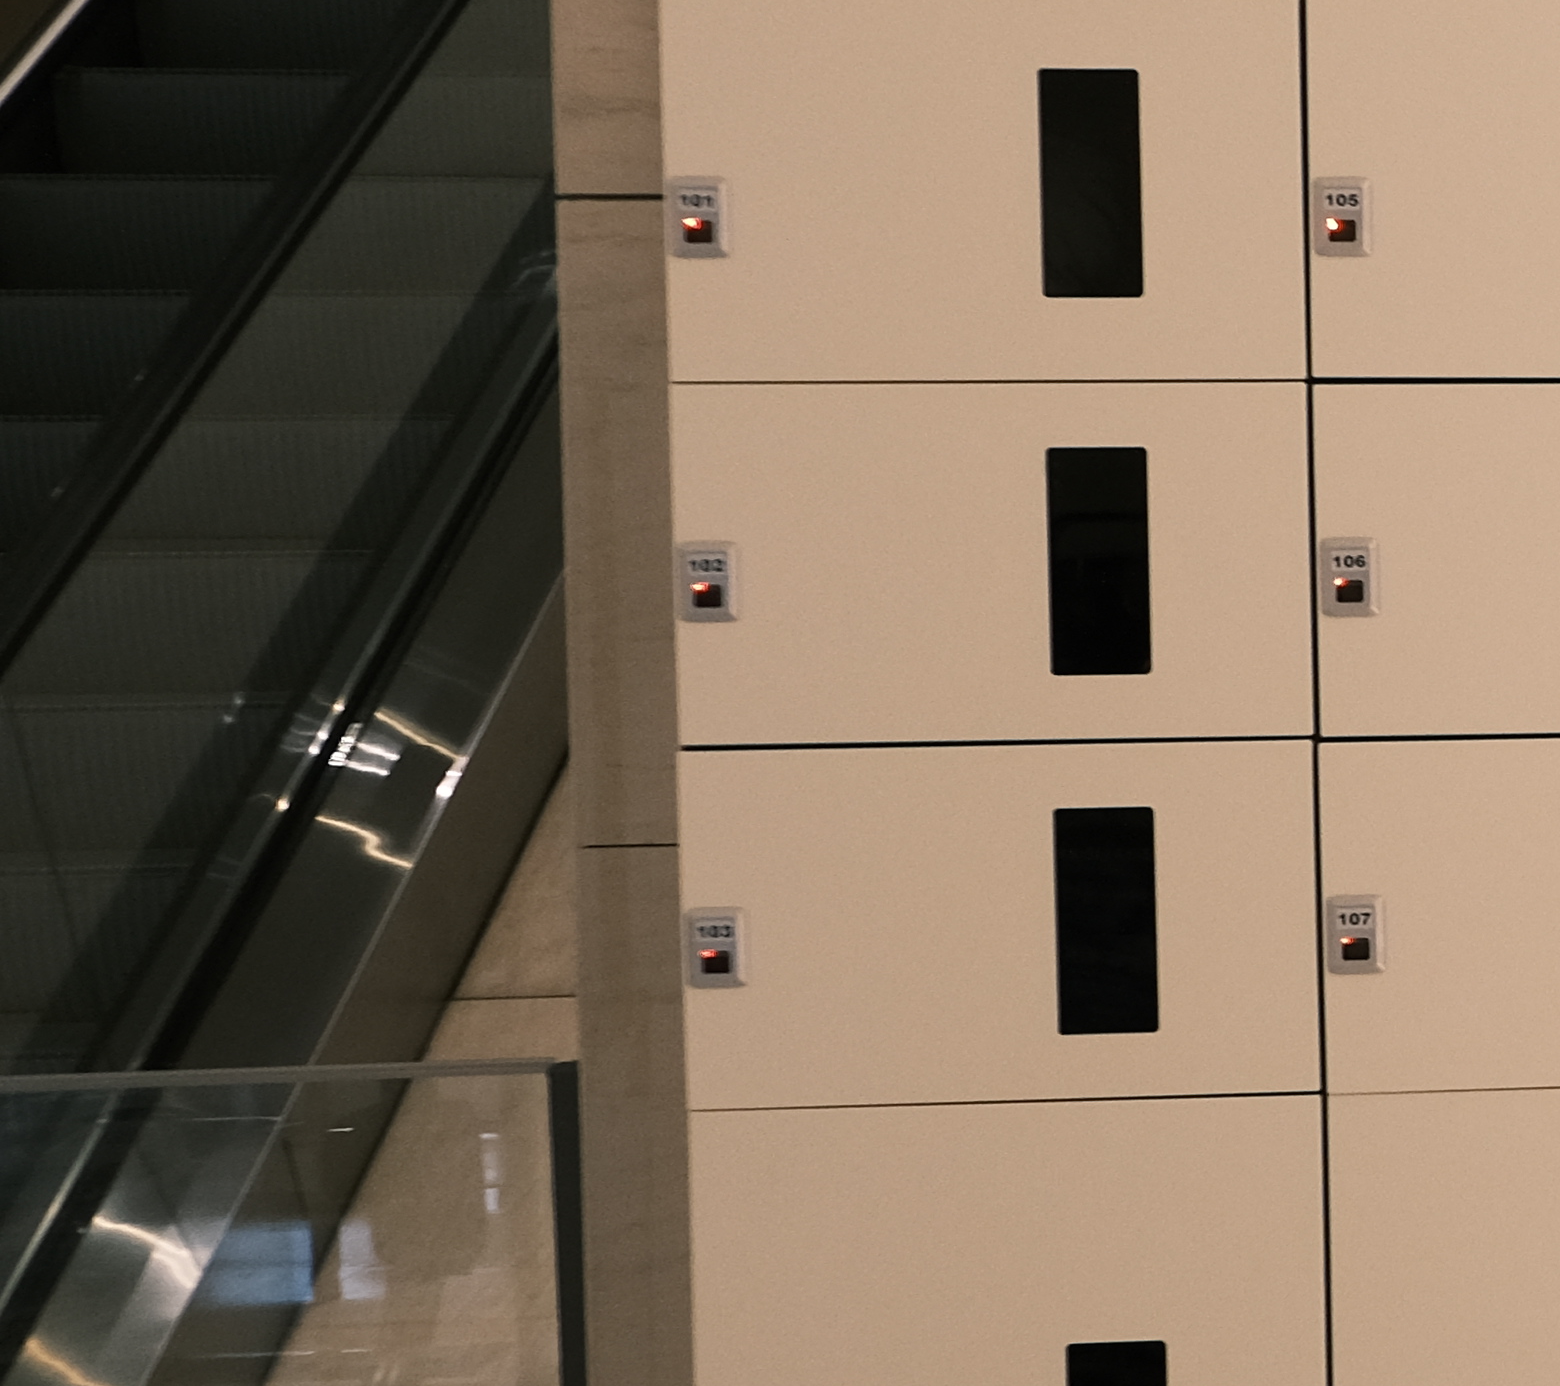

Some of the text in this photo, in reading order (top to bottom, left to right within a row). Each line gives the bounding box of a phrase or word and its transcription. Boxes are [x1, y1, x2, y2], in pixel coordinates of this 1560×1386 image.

[1326, 194, 1358, 207] 105
[1334, 556, 1365, 568] 106
[1339, 913, 1370, 925] 107
